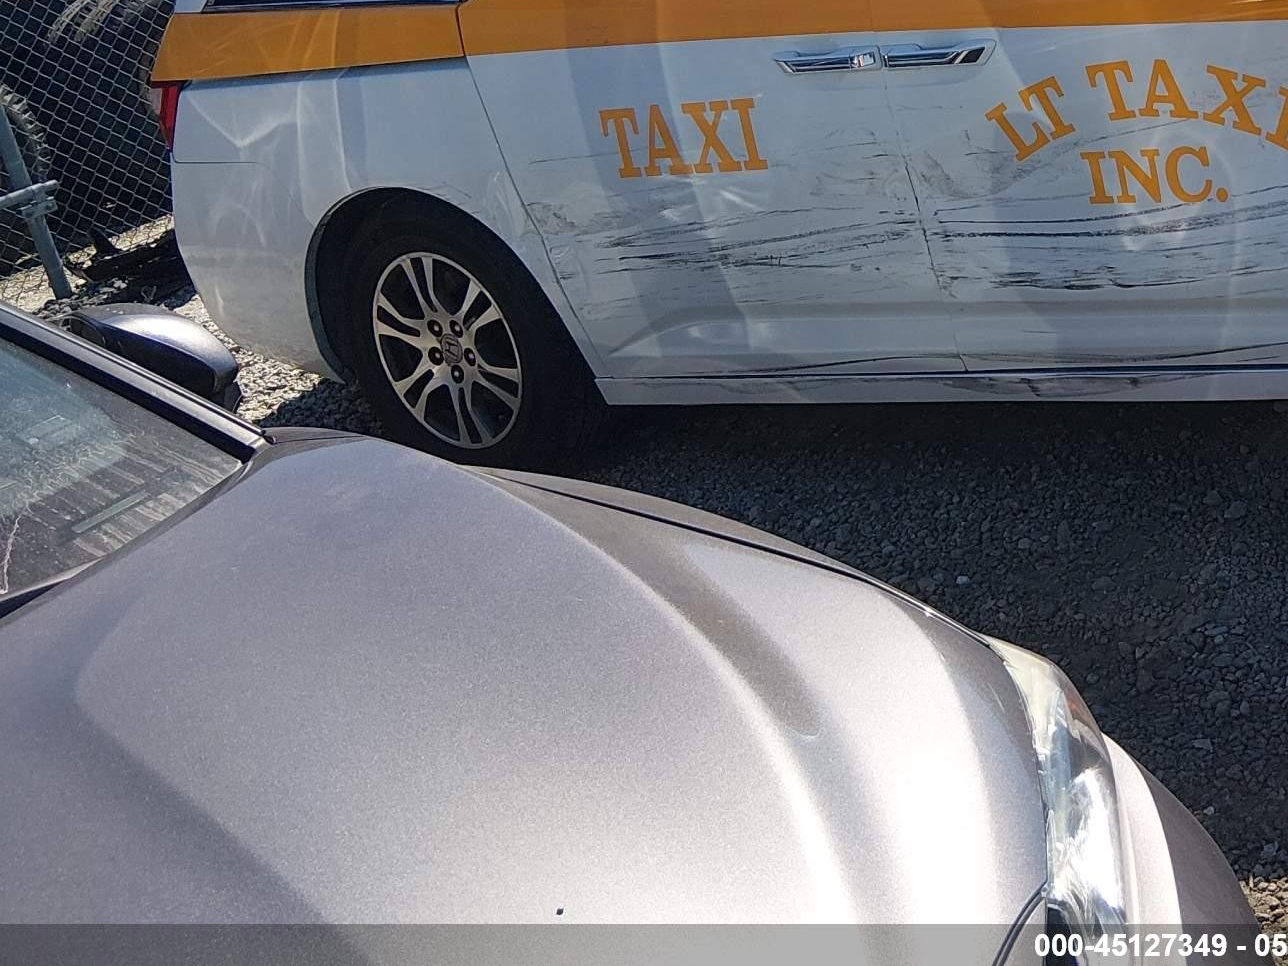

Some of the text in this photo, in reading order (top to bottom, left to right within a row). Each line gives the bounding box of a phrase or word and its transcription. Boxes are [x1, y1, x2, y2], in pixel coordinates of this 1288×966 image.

[598, 98, 769, 178] TAXI
[985, 76, 1076, 161] LT
[1080, 146, 1229, 205] INC.
